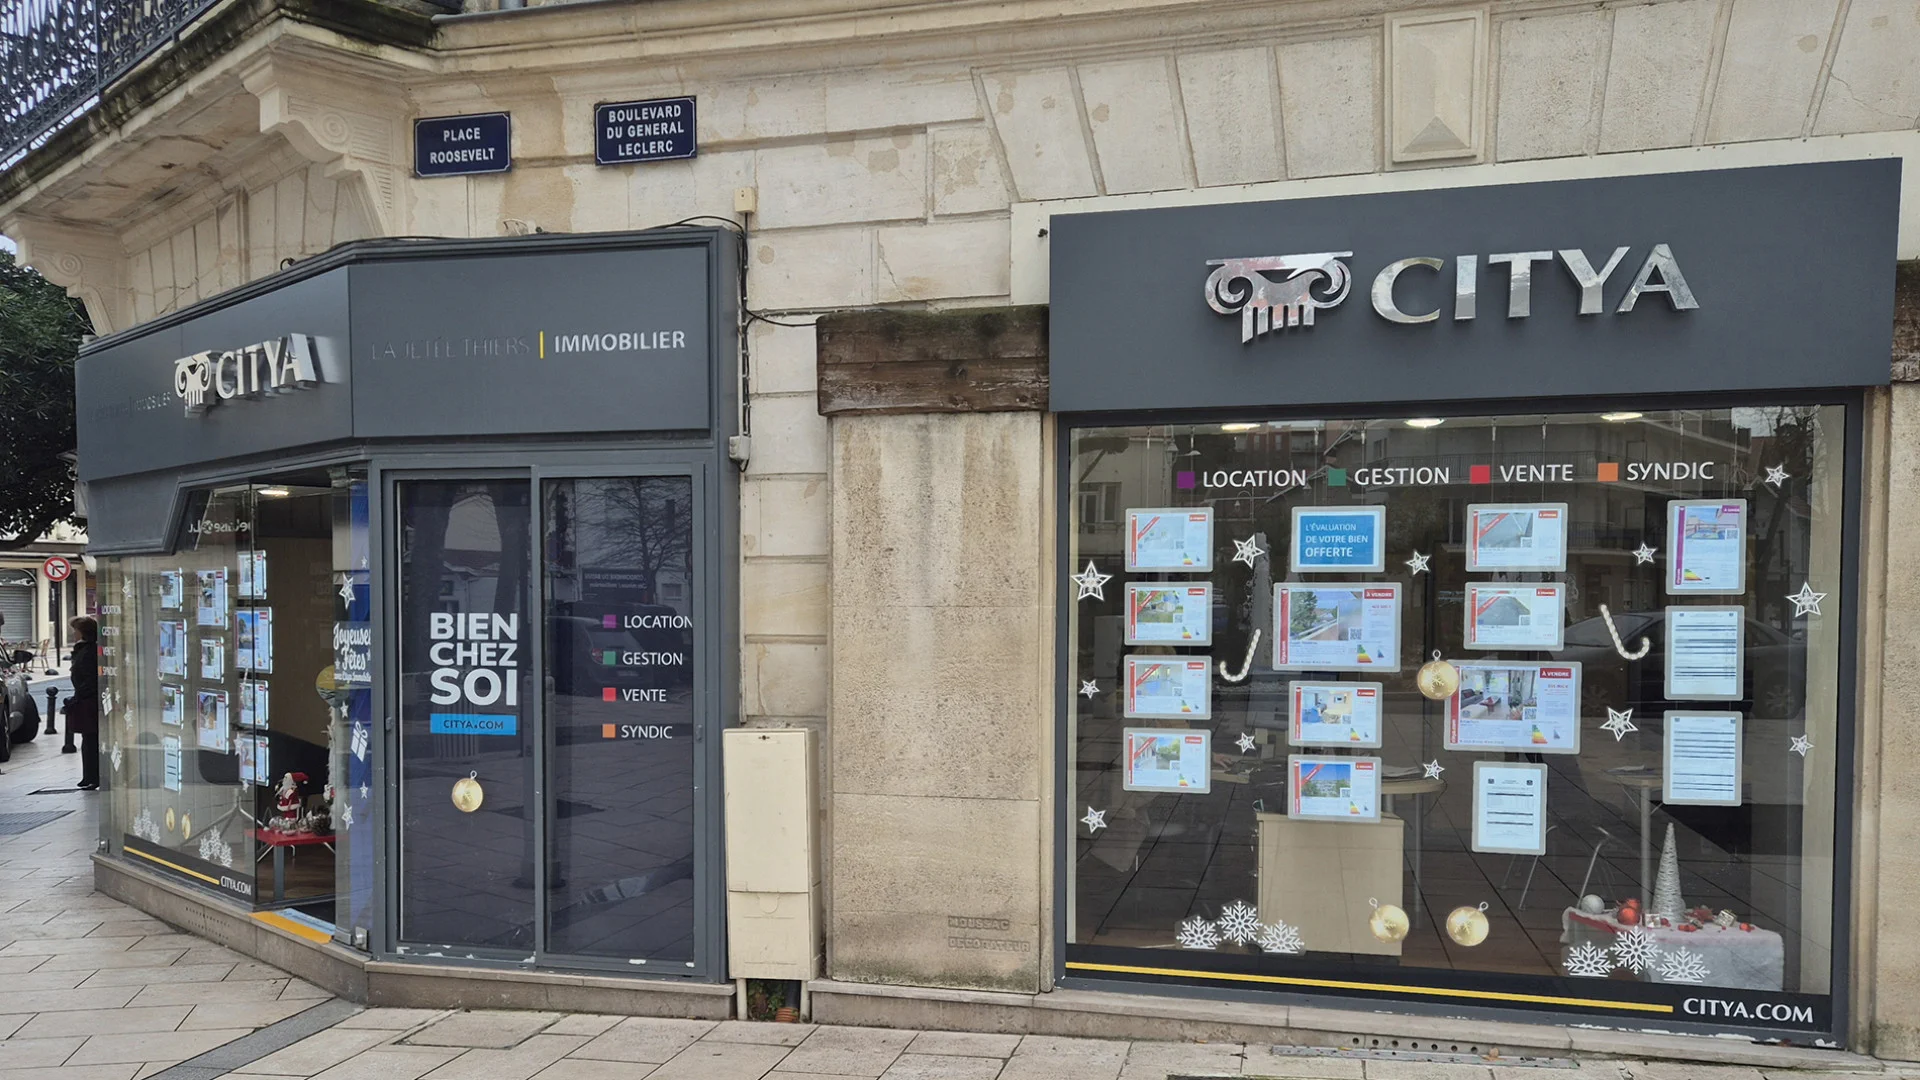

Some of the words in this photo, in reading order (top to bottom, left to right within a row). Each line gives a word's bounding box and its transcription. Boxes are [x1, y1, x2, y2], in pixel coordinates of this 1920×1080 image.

[608, 104, 681, 123] BOULEVARD
[443, 127, 481, 142] PLACE
[606, 127, 623, 139] DU
[628, 121, 684, 138] GENERAL
[430, 147, 495, 164] ROOSEVELT
[618, 140, 673, 156] LECLERC
[1371, 243, 1700, 324] CITYA
[461, 335, 530, 357] THIERS
[554, 330, 686, 353] IMMOBILIER
[216, 333, 316, 399] CITYA
[1203, 469, 1307, 488] LOCATION
[1354, 467, 1450, 486] GESTION
[1500, 464, 1574, 482] VENTE
[1626, 461, 1714, 481] SYNDIC
[1305, 522, 1357, 531] L'ÉVALUATION
[1305, 535, 1317, 543] DE
[1318, 535, 1347, 543] VOTRE
[1348, 534, 1369, 543] BIEN
[1305, 547, 1353, 557] OFFERTE
[430, 612, 518, 640] BIEN
[624, 615, 693, 628] LOCATION
[341, 647, 366, 671] Fêtes
[429, 642, 518, 667] CHEZ
[622, 652, 683, 665] GESTION
[430, 667, 518, 706] SOI
[622, 689, 667, 702] VENTE
[443, 719, 504, 729] CITYA.COM
[621, 725, 673, 738] SYNDIC
[220, 876, 252, 896] CITYA.COM
[1683, 998, 1814, 1023] CITYA.COM
